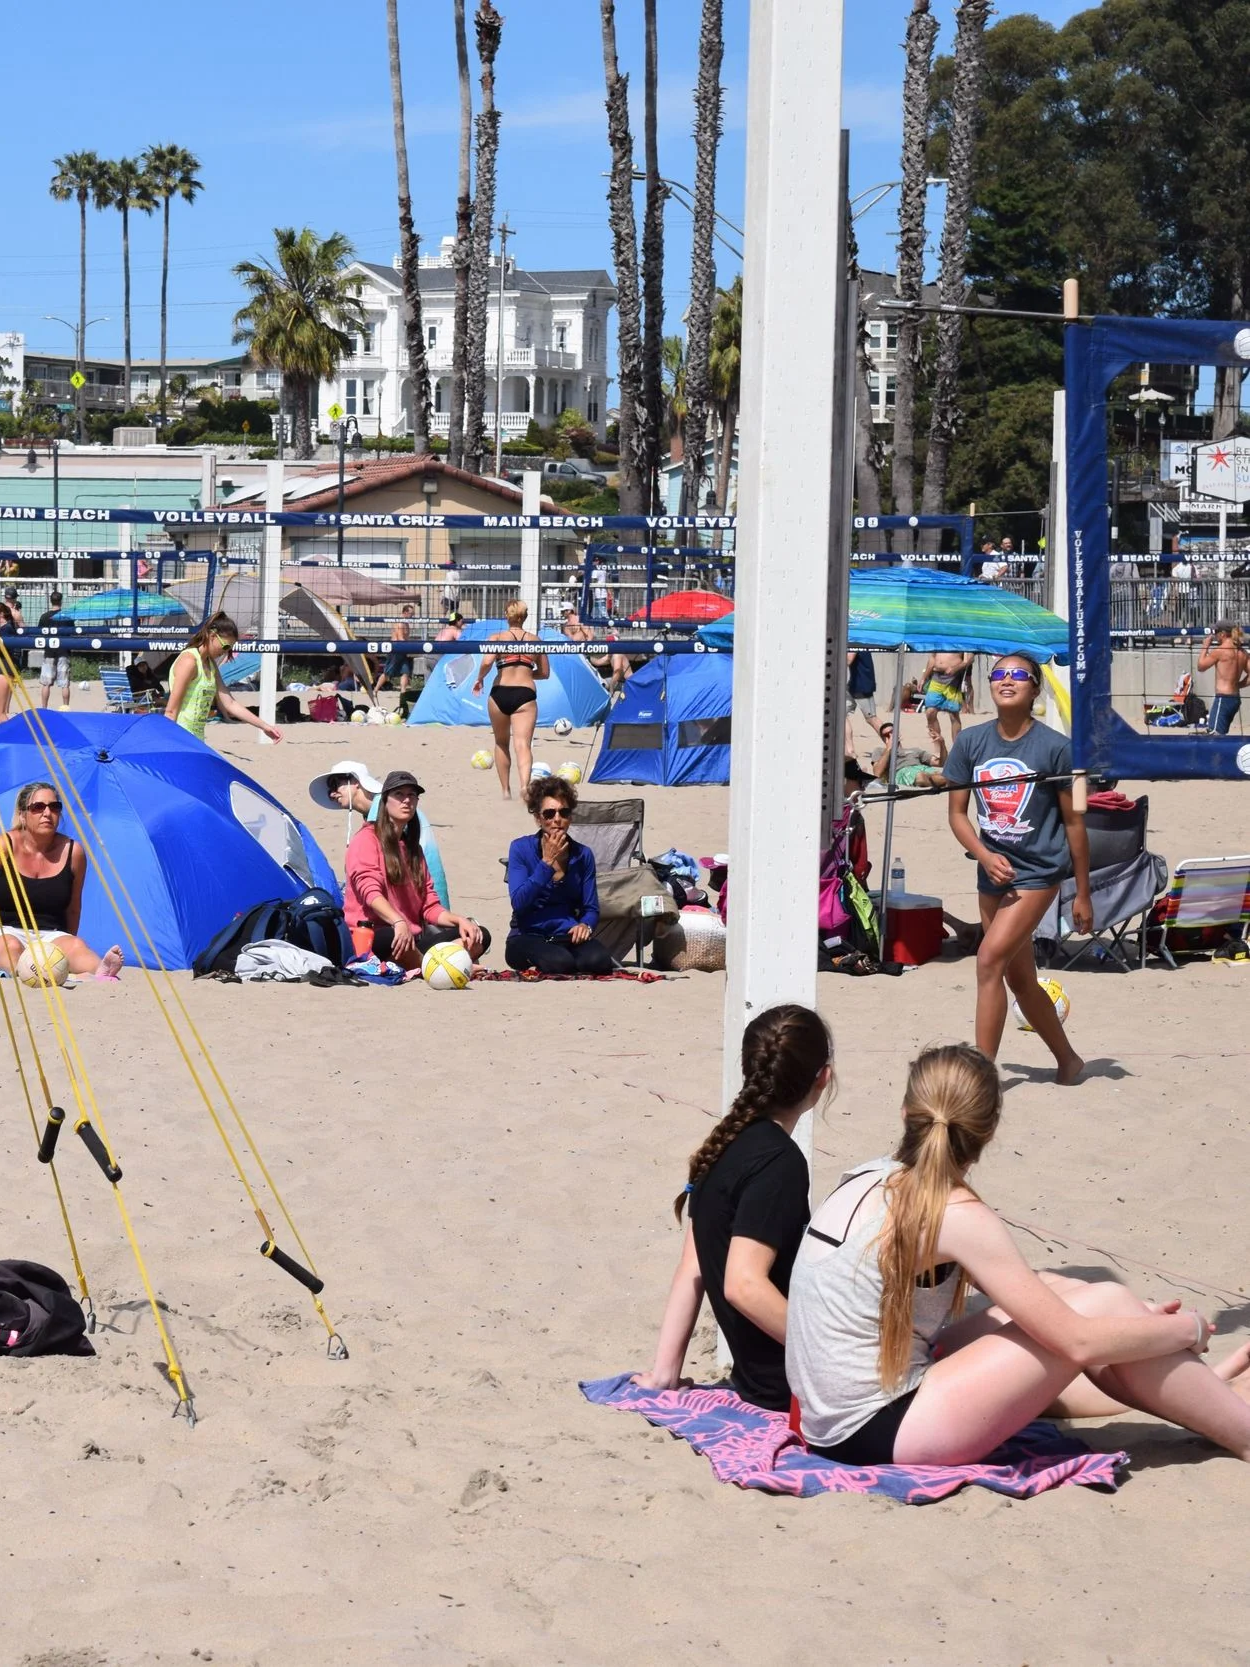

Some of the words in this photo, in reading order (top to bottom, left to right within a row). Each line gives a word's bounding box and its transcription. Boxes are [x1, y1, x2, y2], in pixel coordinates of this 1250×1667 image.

[44, 509, 110, 520] BEACH
[154, 511, 276, 523] VOLLEYBALL
[340, 514, 394, 525] SANTA
[399, 515, 445, 526] CRUZ
[484, 516, 531, 527] MAIN
[539, 517, 603, 528] BEACH
[1122, 554, 1160, 562] BEACH
[479, 643, 609, 653] www.santacruzwharf.com
